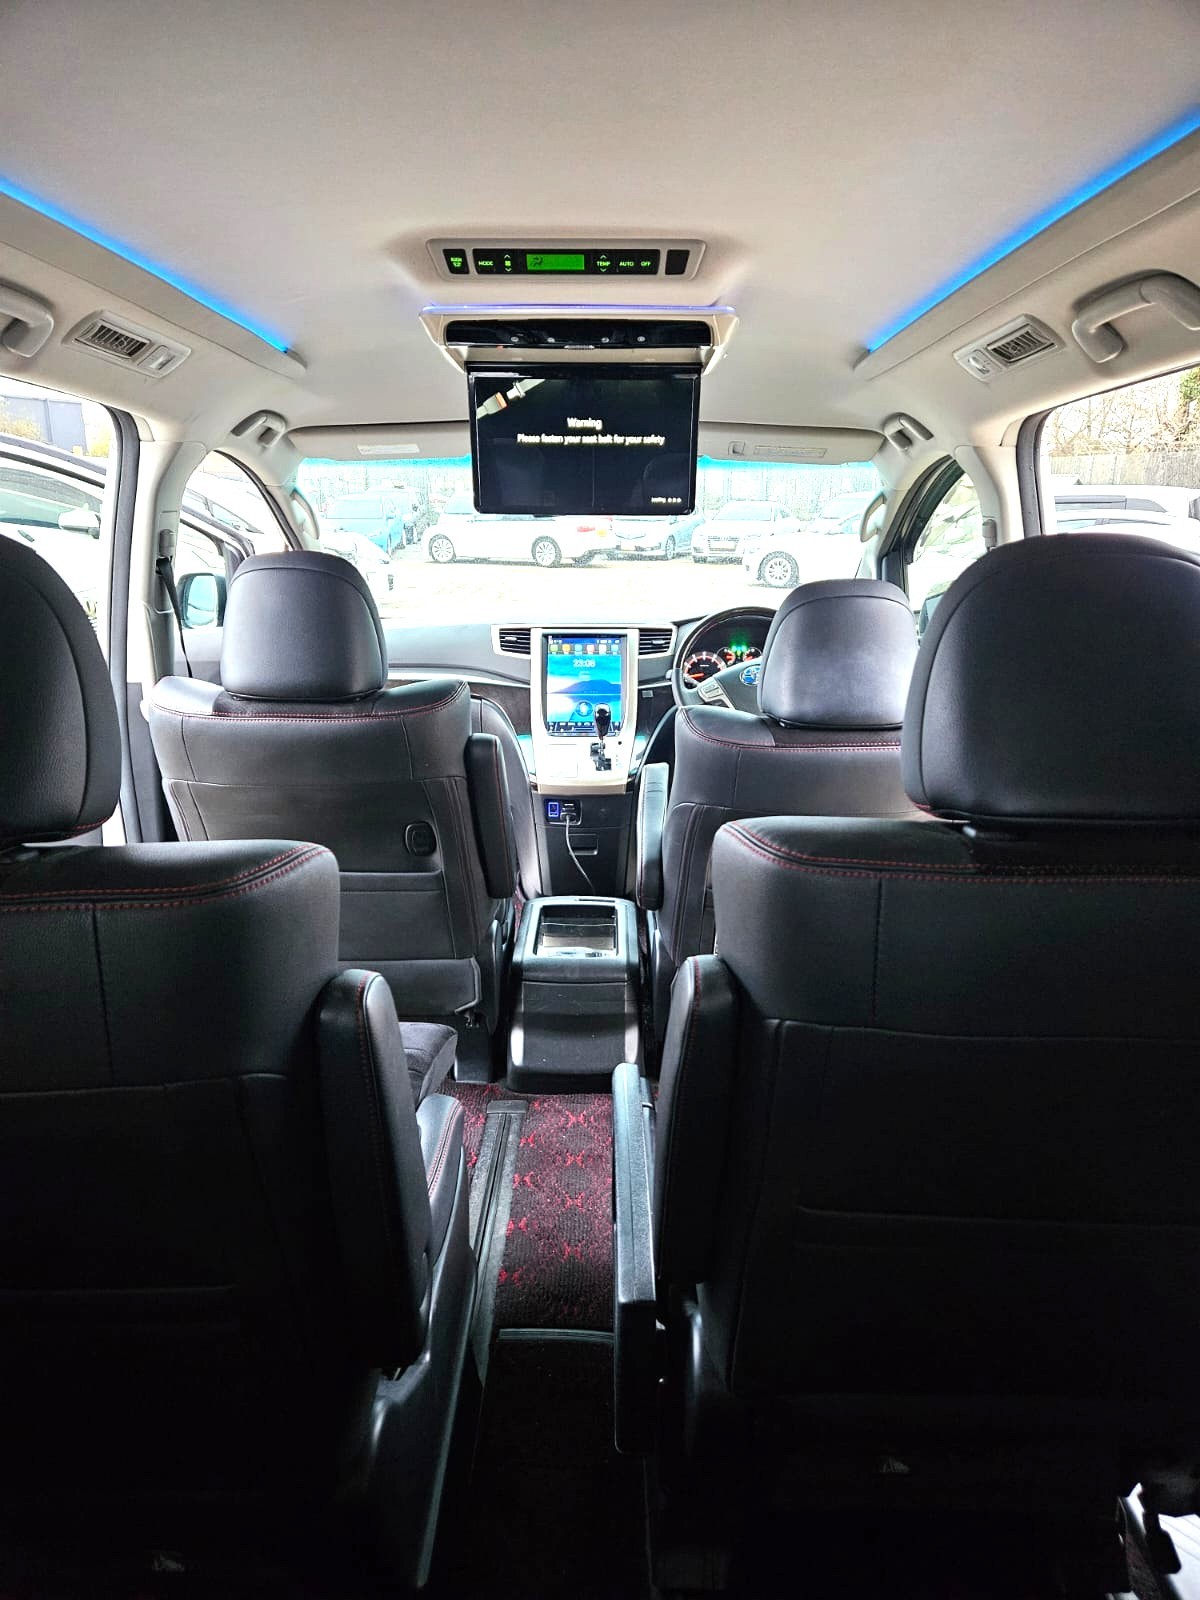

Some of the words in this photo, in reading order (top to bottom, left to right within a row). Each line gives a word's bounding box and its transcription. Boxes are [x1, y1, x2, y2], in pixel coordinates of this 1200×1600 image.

[567, 417, 603, 430] Warning
[517, 433, 540, 443] Please
[541, 433, 563, 443] fasten
[564, 435, 581, 445] your
[582, 434, 597, 443] seat
[598, 434, 612, 443] belt
[613, 434, 625, 443] for
[625, 435, 643, 445] your
[643, 434, 666, 446] safety
